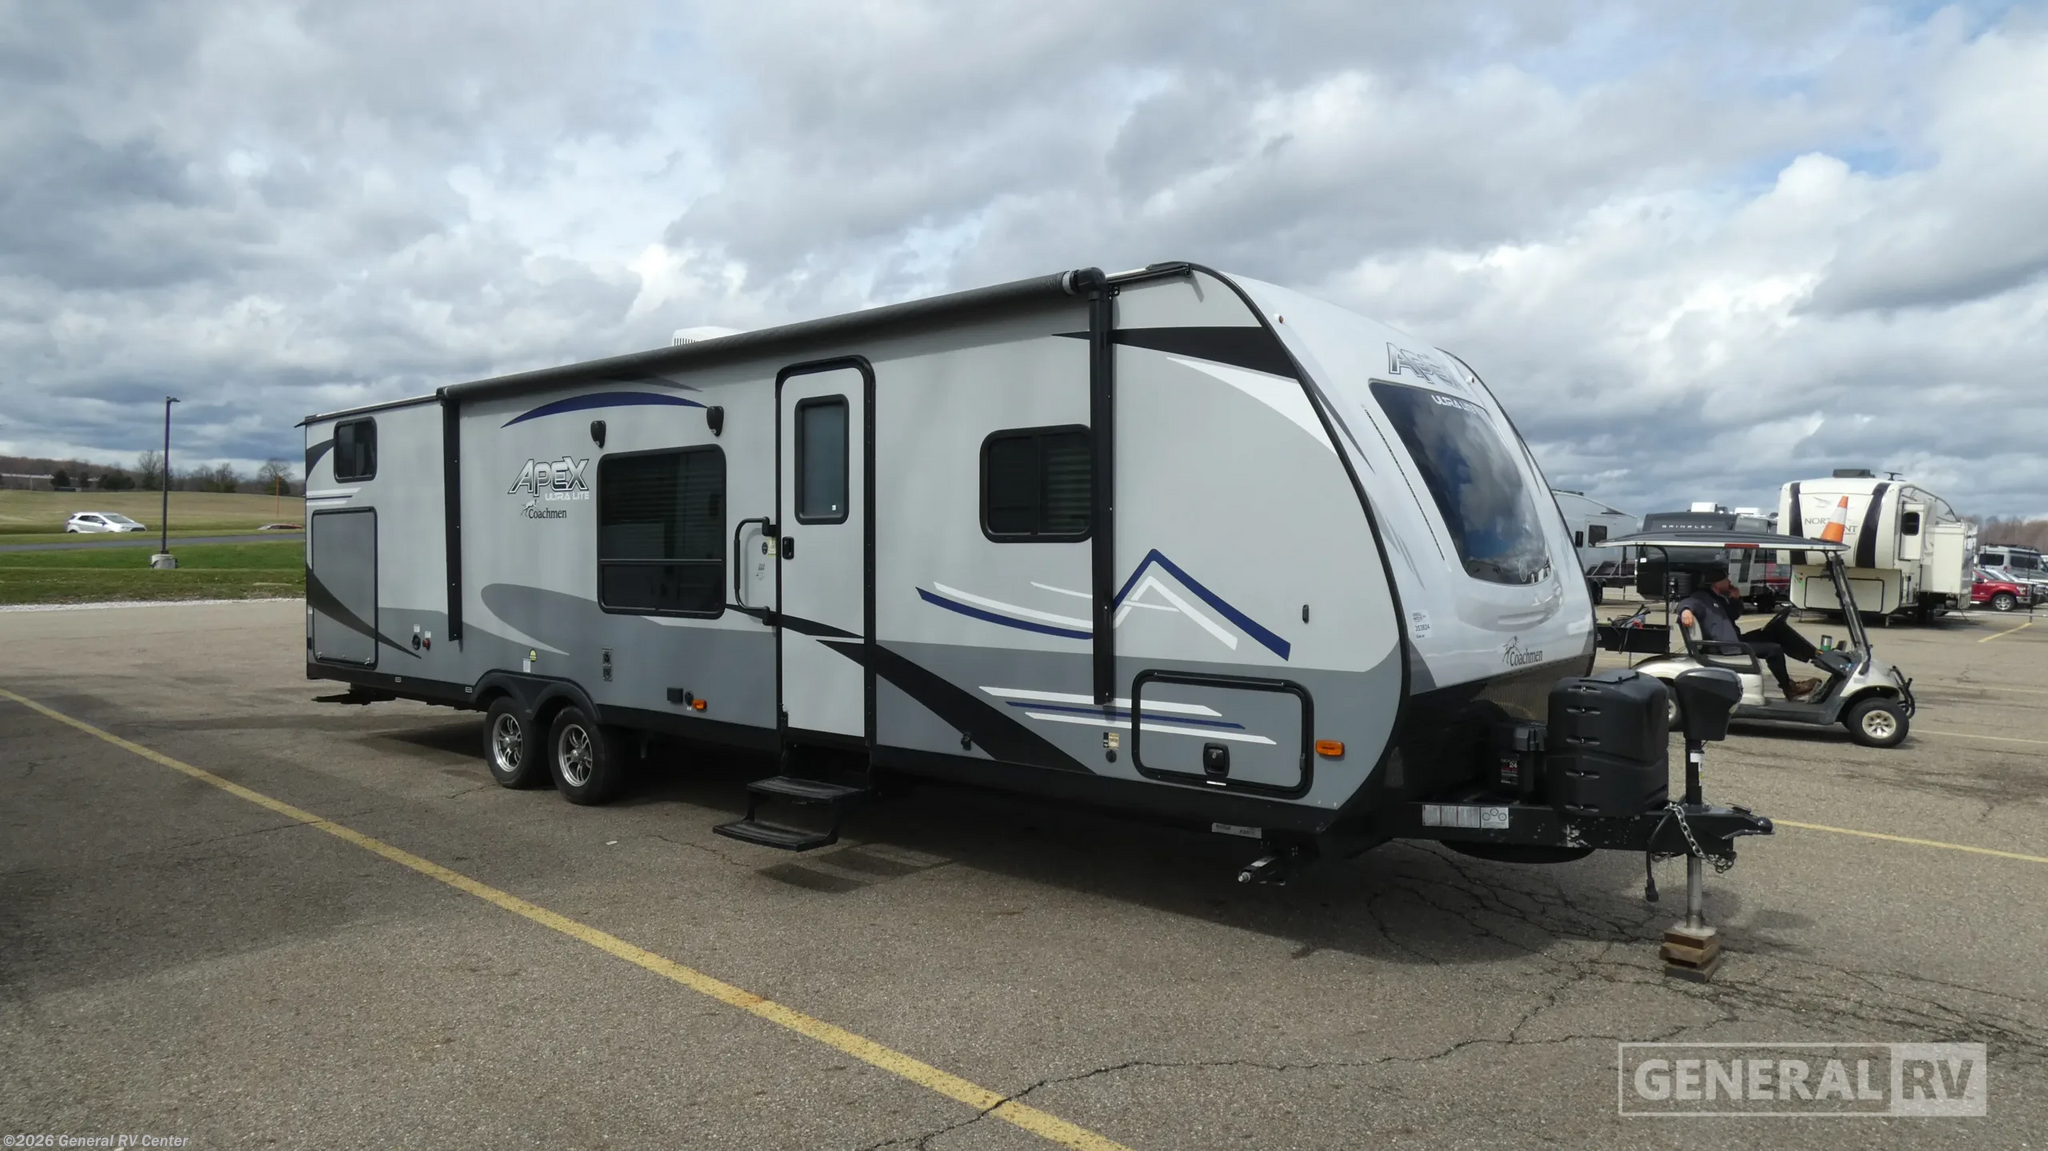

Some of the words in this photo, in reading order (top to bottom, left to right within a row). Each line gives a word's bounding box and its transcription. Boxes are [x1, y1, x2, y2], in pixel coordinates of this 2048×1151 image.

[1431, 395, 1462, 409] ULTRA
[507, 456, 589, 497] APEX
[545, 493, 571, 501] ULTRA
[572, 492, 589, 500] LITE
[528, 508, 567, 519] Coachmen
[1804, 517, 1830, 525] NOR
[1510, 648, 1543, 667] Coachmen
